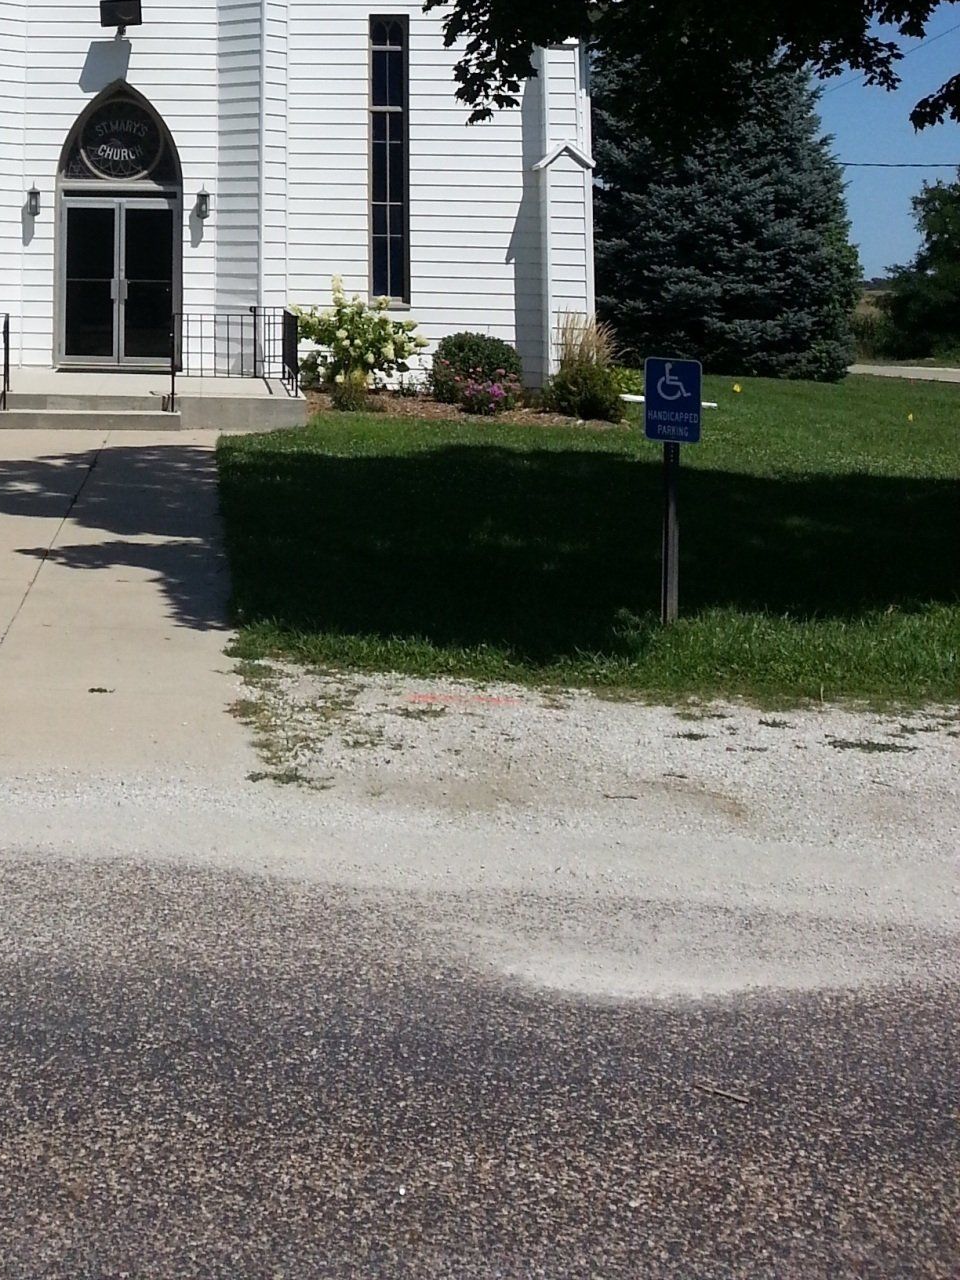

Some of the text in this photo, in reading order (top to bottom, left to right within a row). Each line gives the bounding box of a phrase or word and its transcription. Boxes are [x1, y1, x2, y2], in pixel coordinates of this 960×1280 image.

[97, 144, 144, 161] CHURCH
[647, 410, 699, 424] HANDICAPPED
[657, 424, 689, 437] PARKING
